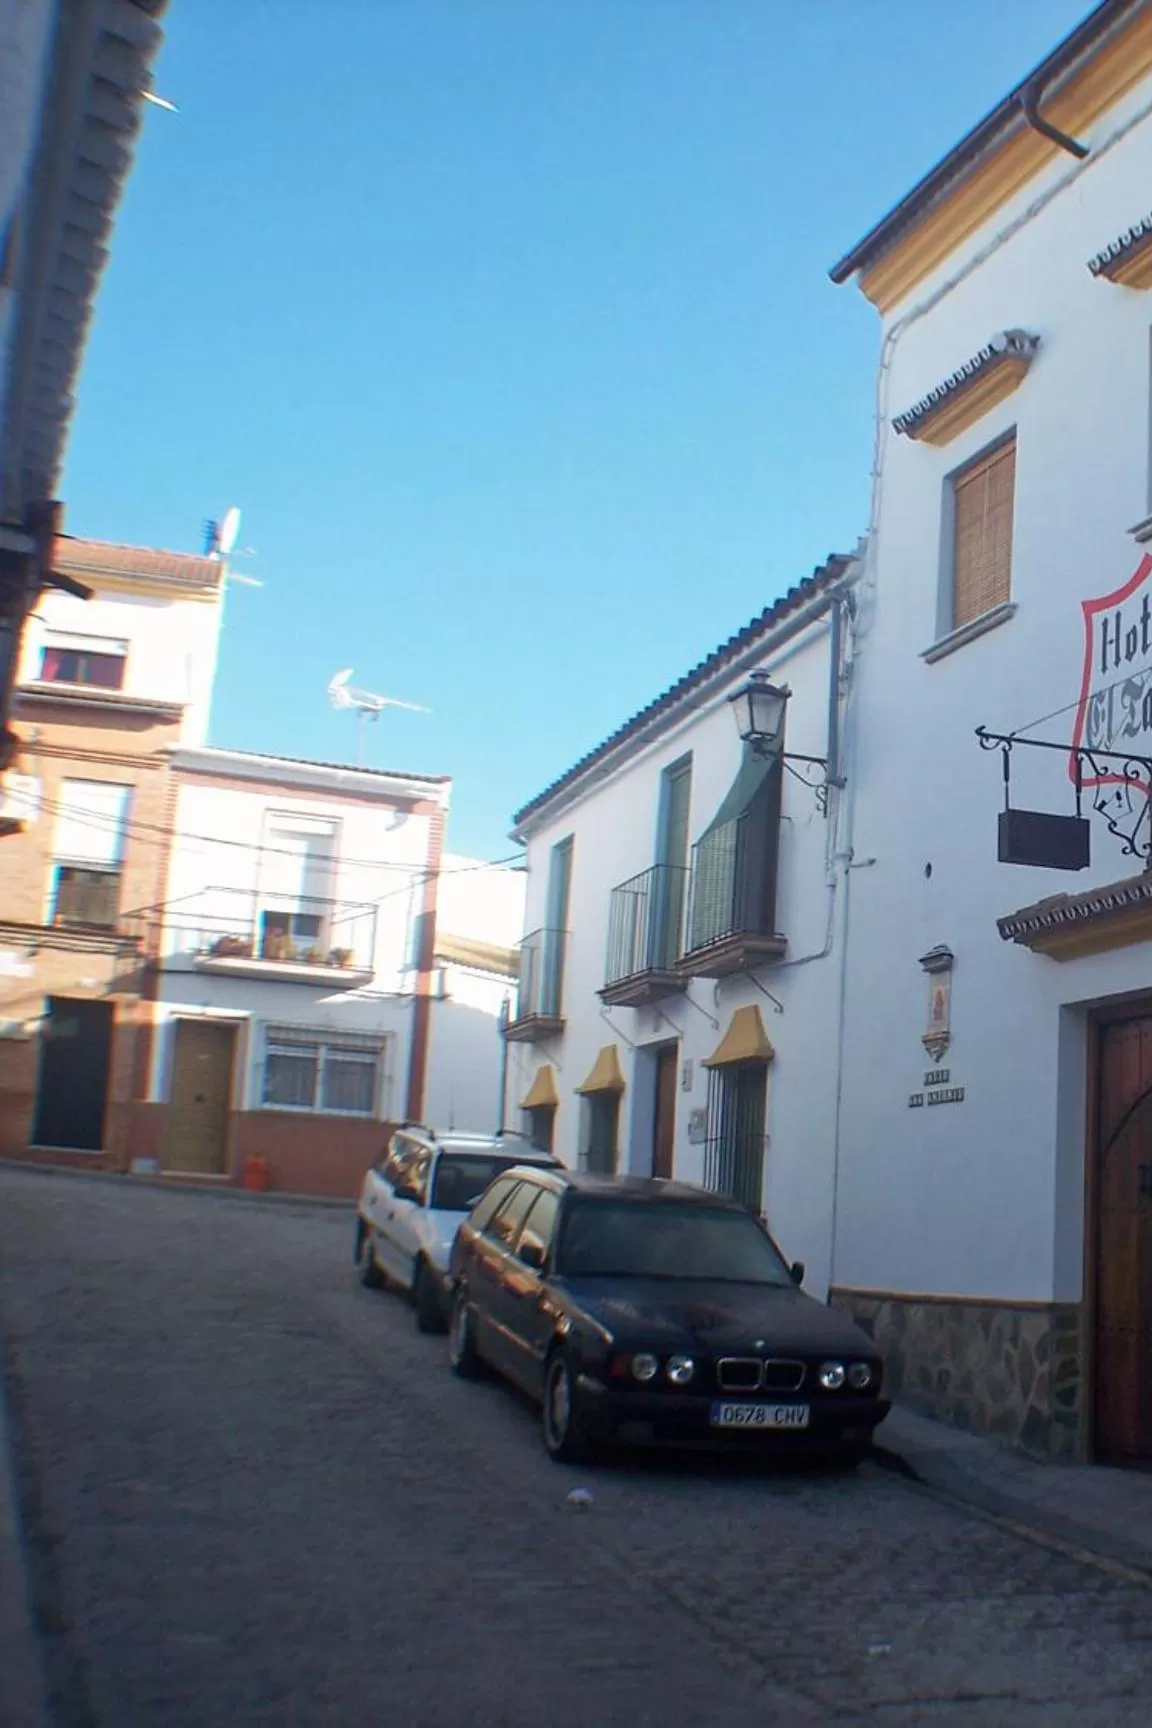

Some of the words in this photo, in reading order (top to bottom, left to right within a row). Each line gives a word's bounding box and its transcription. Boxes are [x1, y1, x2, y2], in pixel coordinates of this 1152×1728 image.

[1086, 685, 1115, 750] El
[724, 1406, 765, 1425] 0678
[774, 1407, 805, 1425] CHV
